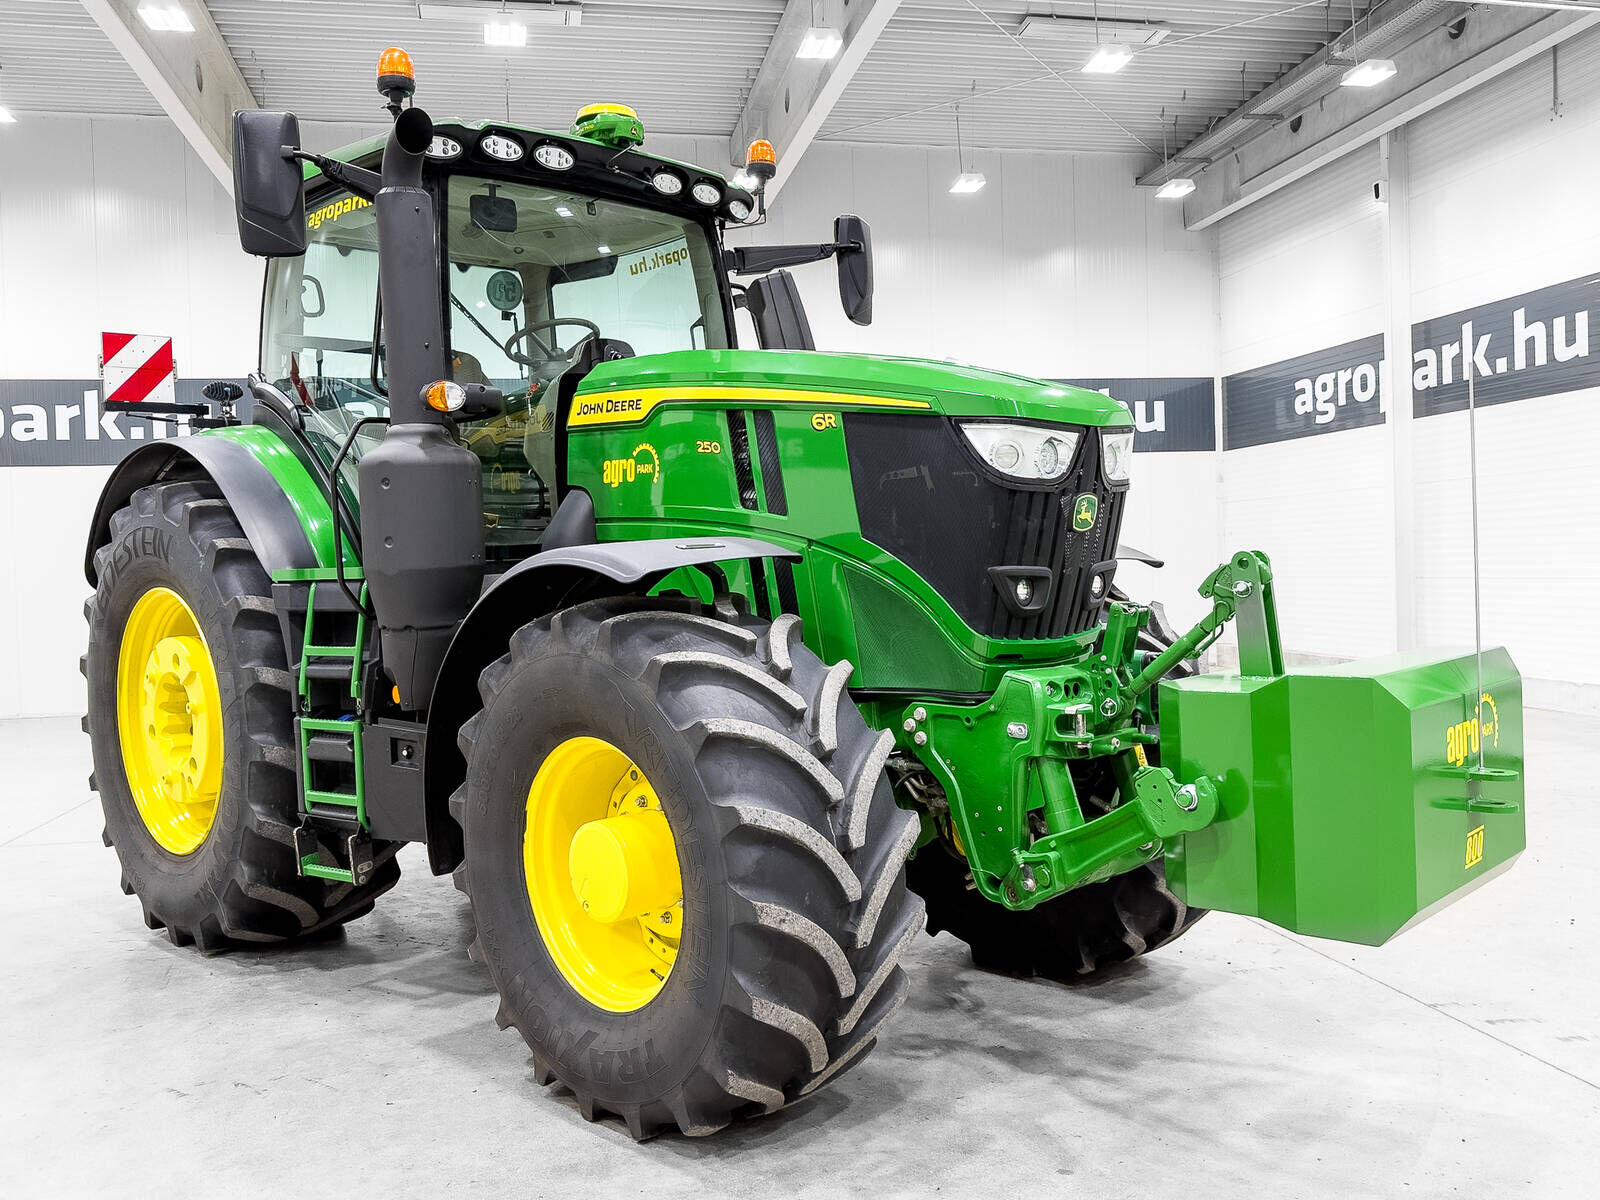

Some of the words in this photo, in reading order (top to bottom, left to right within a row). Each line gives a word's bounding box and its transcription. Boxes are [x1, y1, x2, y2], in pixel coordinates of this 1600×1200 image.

[576, 400, 604, 416] JOHN
[606, 399, 642, 413] DEERE
[811, 413, 837, 431] 6R
[696, 440, 721, 454] 250
[603, 457, 636, 488] agro
[636, 464, 653, 475] PARK
[1446, 717, 1480, 768] agro
[1466, 830, 1484, 864] 800
